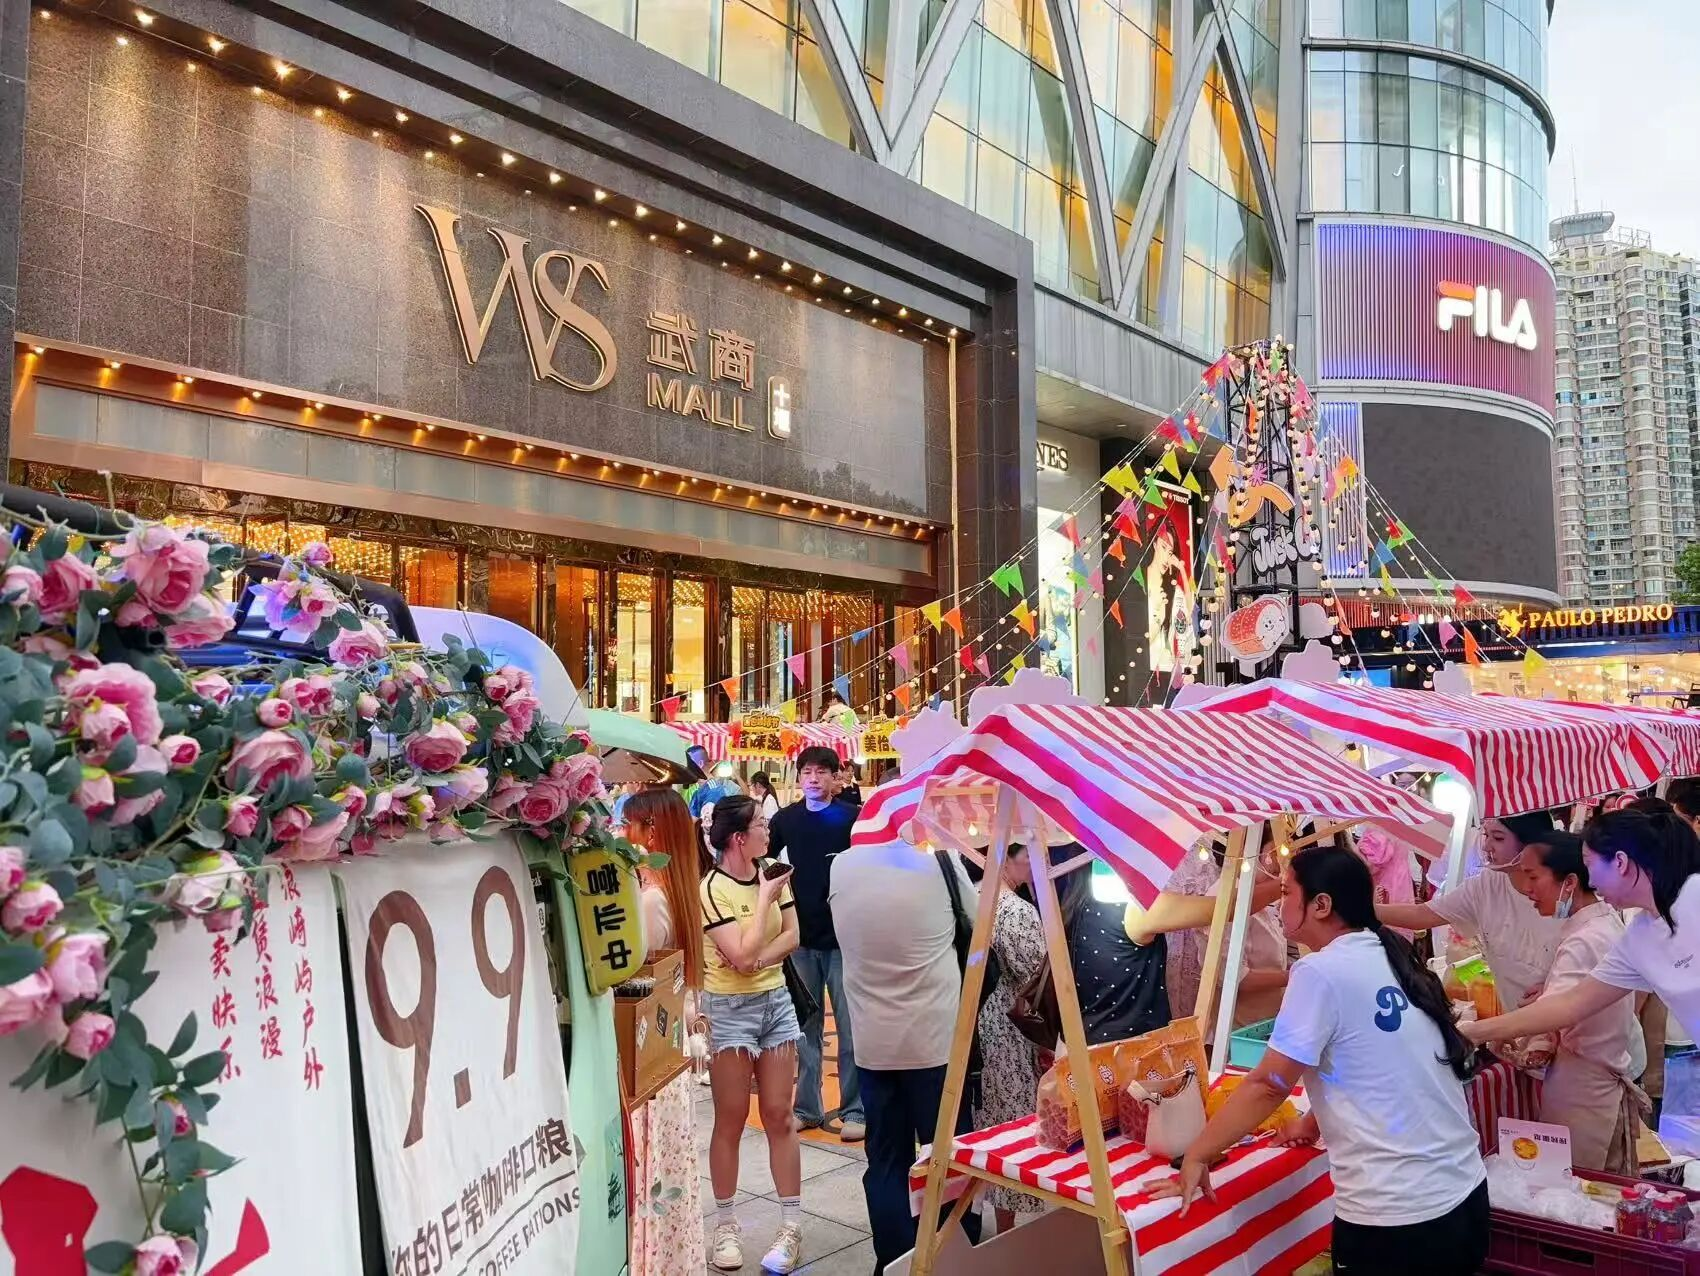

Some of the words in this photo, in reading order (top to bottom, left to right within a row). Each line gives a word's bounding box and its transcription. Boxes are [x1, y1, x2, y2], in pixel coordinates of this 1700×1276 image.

[646, 311, 756, 391] 武商
[1437, 280, 1538, 351] FILA
[646, 372, 756, 433] MALL
[1529, 607, 1596, 629] PAULO
[1601, 603, 1673, 624] PEDRO
[586, 862, 632, 970] 营业中
[365, 865, 525, 1149] 9.9
